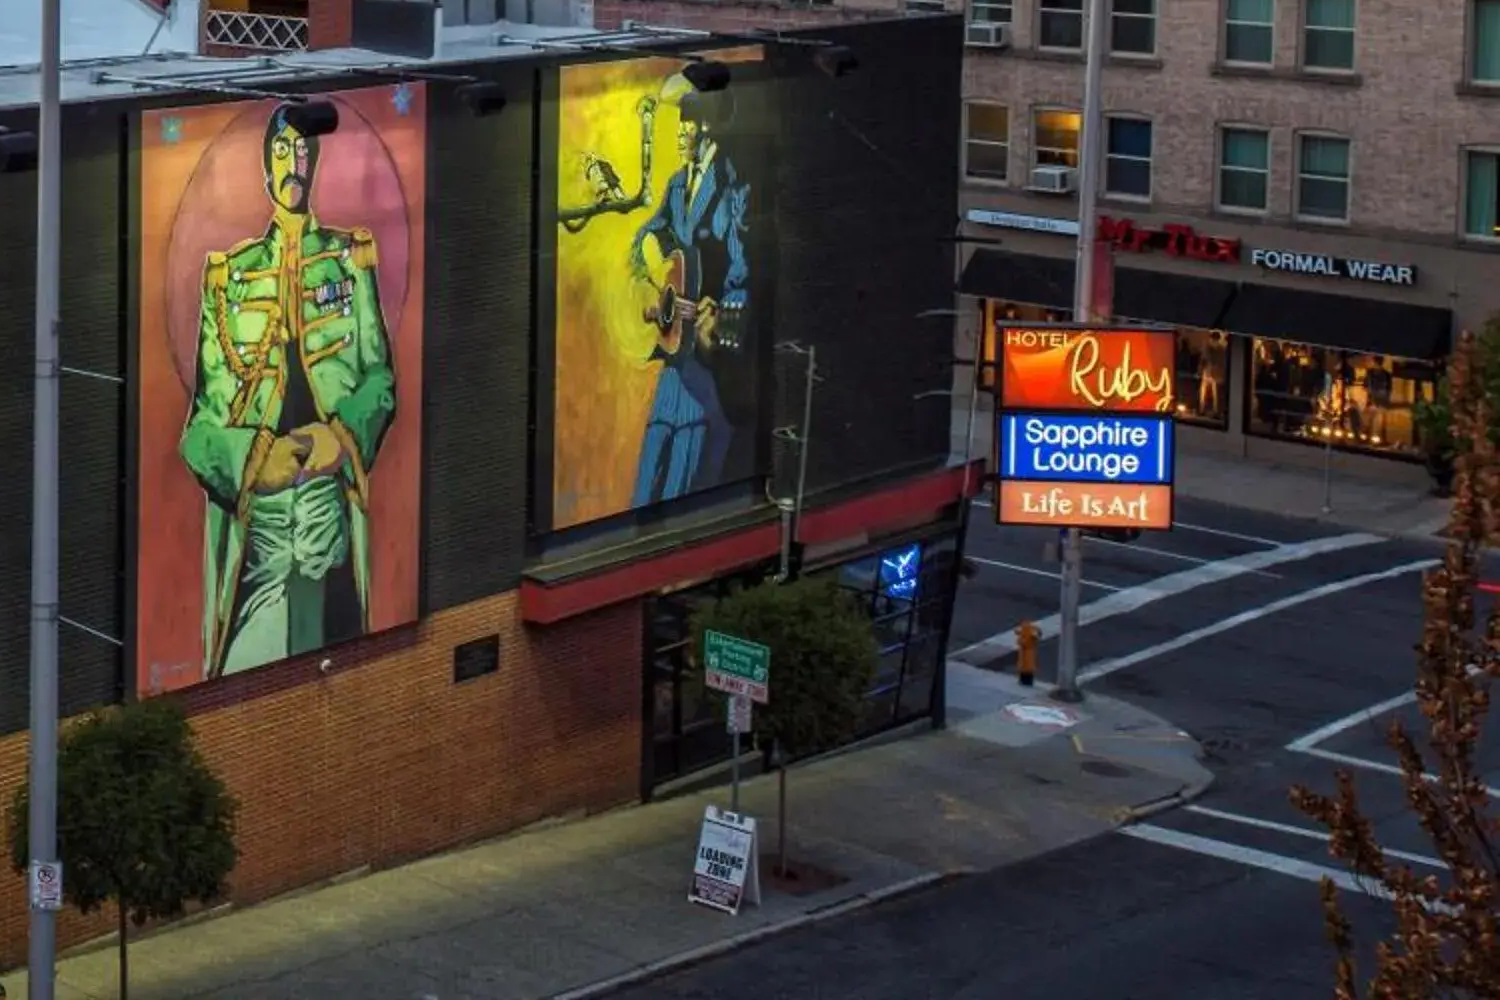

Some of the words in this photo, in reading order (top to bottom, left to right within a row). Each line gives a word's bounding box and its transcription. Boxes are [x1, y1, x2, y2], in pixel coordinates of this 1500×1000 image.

[1251, 249, 1341, 276] FORMAL
[1347, 260, 1413, 286] WEAR
[1006, 331, 1074, 348] HOTEL
[1071, 335, 1174, 412] Ruby
[1024, 418, 1149, 449] Sapphire
[1032, 446, 1140, 478] Lounge
[1021, 487, 1074, 518] Life
[1080, 493, 1104, 518] Is
[1108, 491, 1150, 521] Art
[700, 846, 744, 869] LOADING
[707, 862, 732, 880] ZONE
